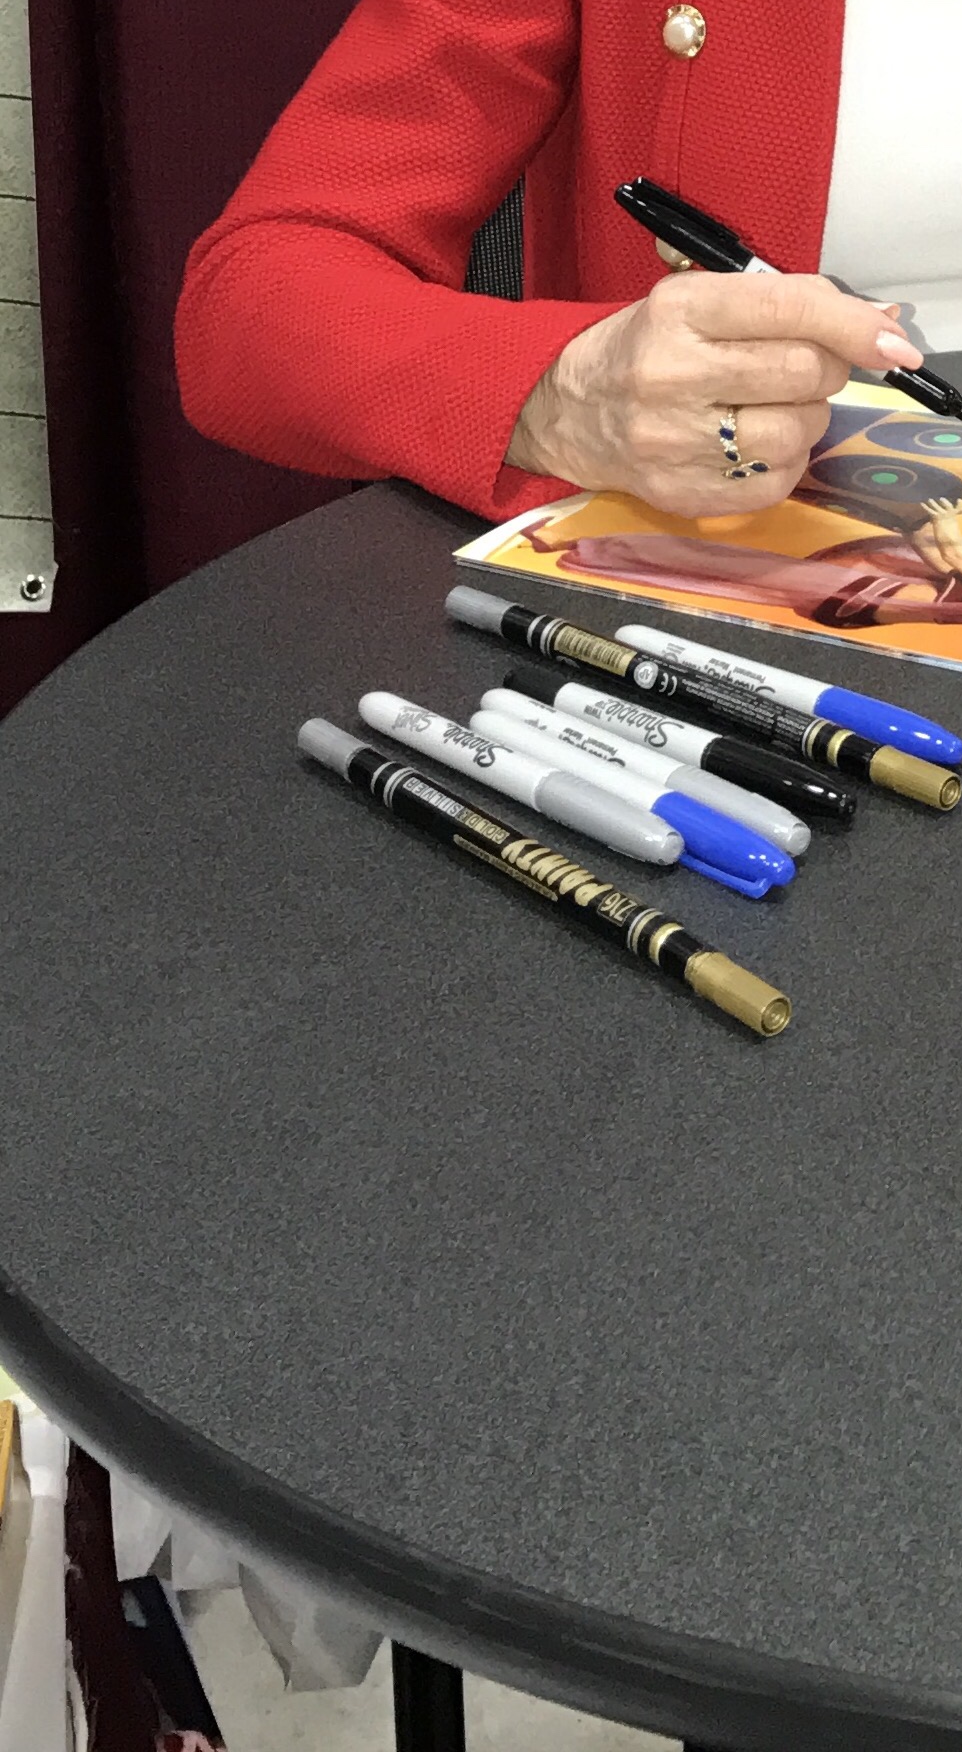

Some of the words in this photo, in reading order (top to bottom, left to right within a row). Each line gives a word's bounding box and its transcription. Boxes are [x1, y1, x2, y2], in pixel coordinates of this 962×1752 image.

[443, 723, 514, 769] Sharpie
[605, 698, 684, 748] Sharpie
[500, 838, 615, 907] PAINTY
[599, 892, 638, 923] ZIG
